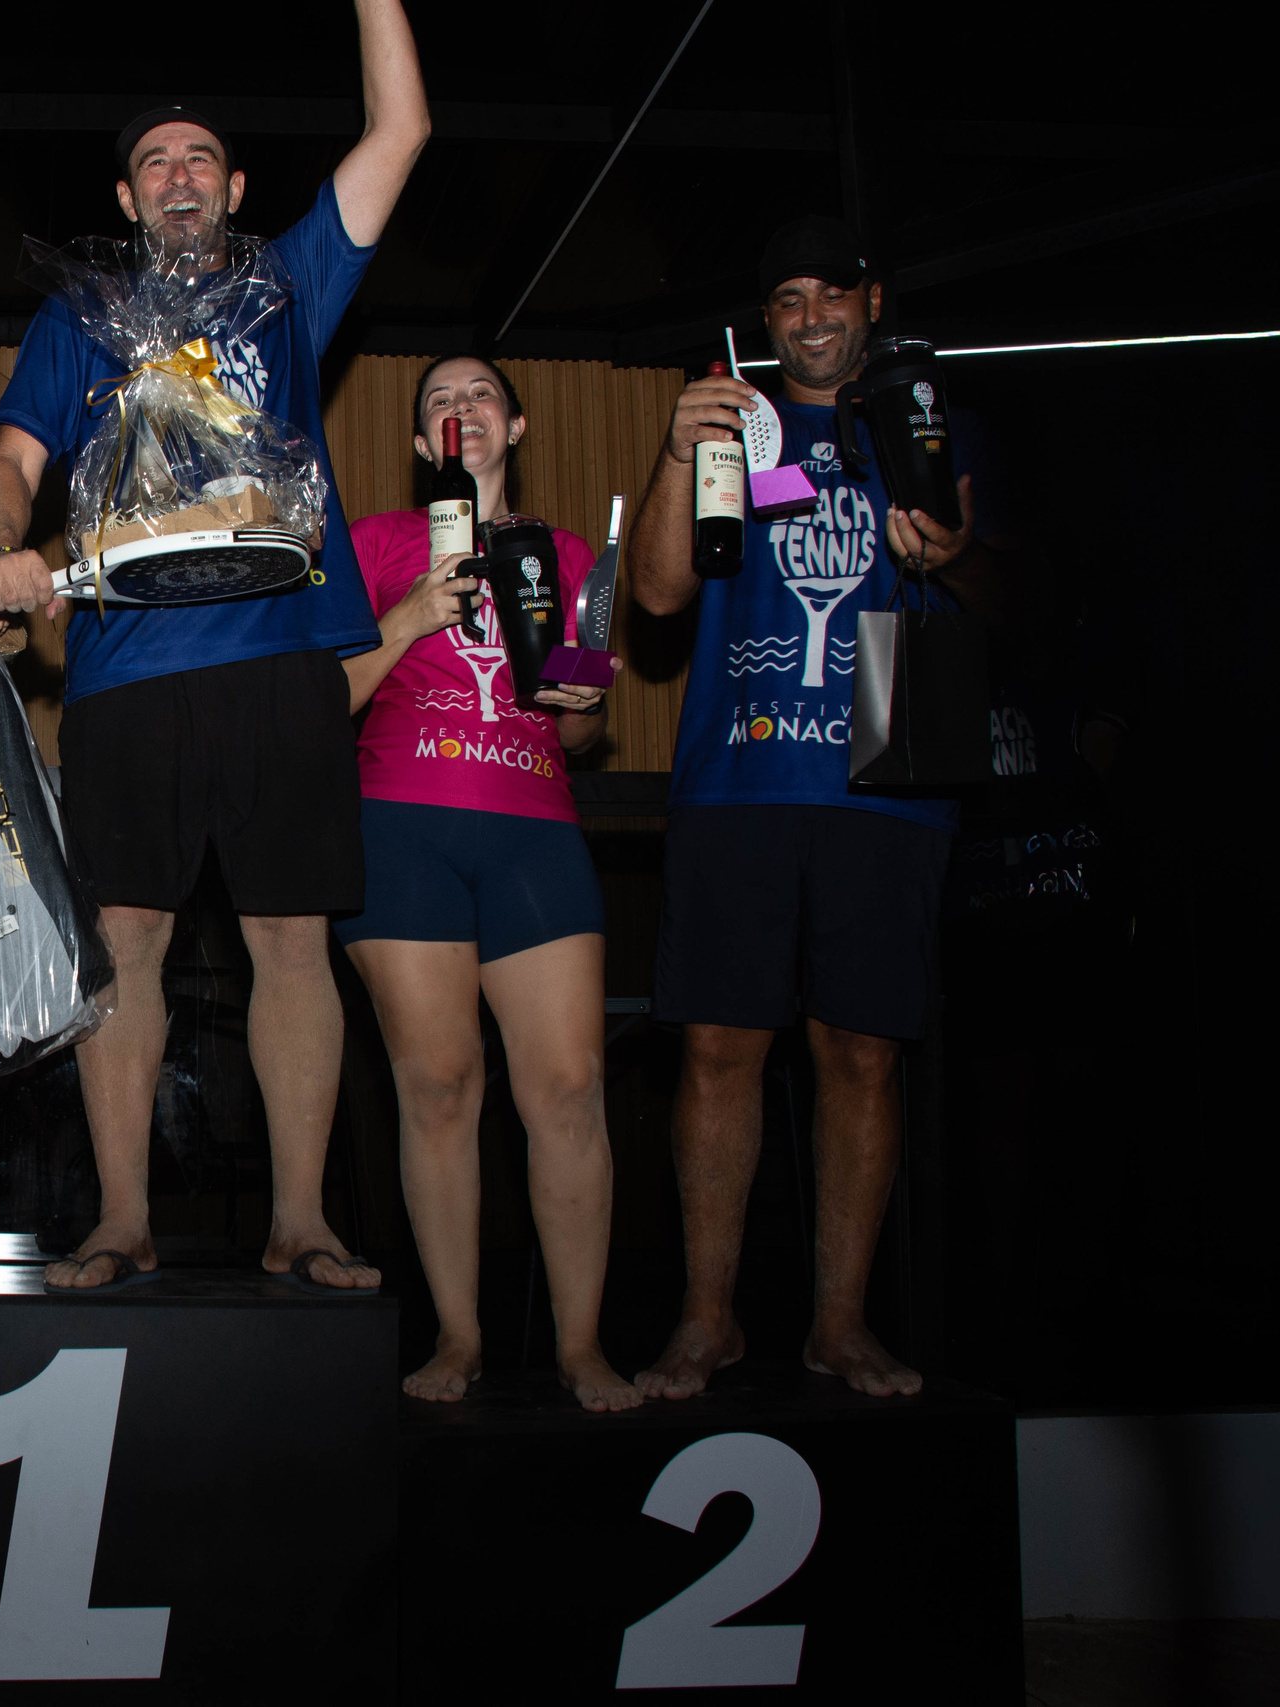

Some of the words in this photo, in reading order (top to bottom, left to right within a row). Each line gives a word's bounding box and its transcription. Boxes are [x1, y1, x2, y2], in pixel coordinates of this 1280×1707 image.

[709, 452, 743, 465] TORO
[798, 459, 843, 473] ATLAS
[429, 513, 458, 525] TORO
[771, 486, 876, 531] ACH
[768, 524, 876, 578] TENNIS
[733, 700, 852, 719] FESTIV
[727, 716, 853, 745] MONAC
[415, 738, 554, 779] MONACO26
[614, 1431, 822, 1690] 2
